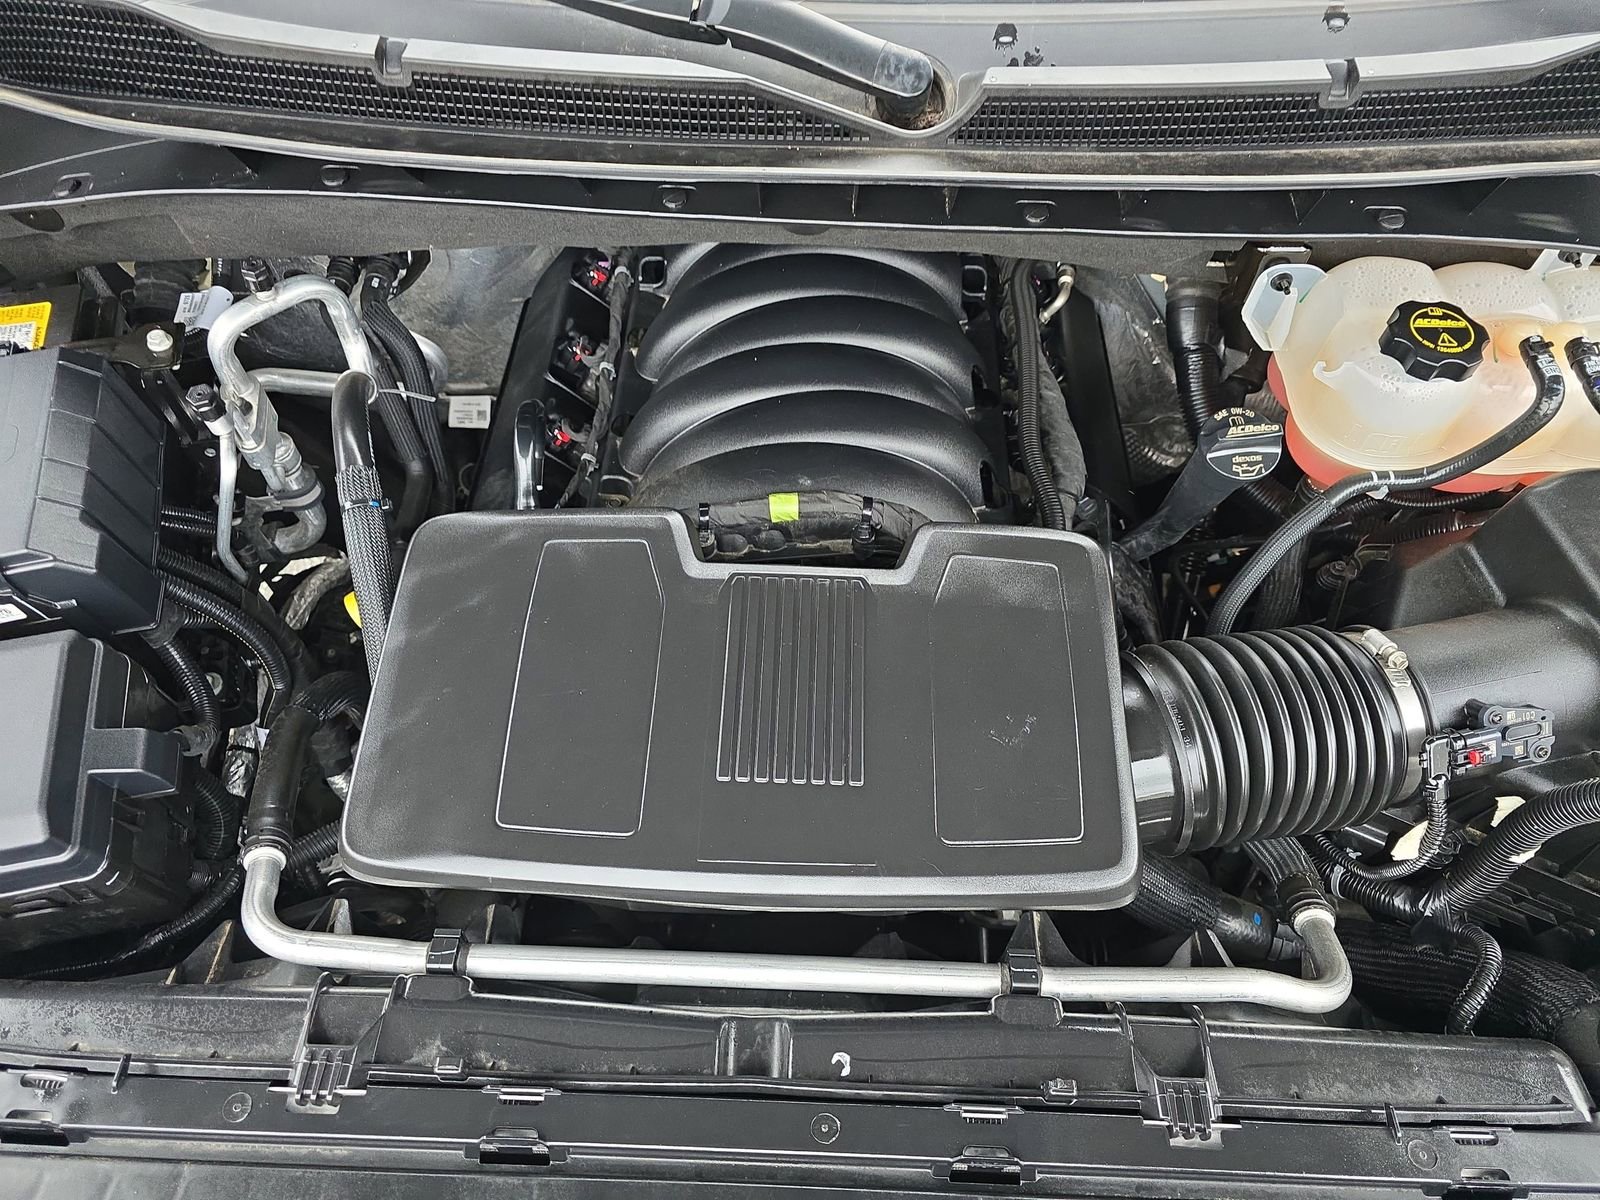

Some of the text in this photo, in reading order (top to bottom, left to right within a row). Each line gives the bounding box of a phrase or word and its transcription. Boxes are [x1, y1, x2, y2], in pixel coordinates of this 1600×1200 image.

[1413, 318, 1467, 328] ACDelco
[1214, 407, 1255, 421] SAE 0W-20
[1227, 423, 1280, 436] ACDelco
[1232, 454, 1263, 463] dexos
